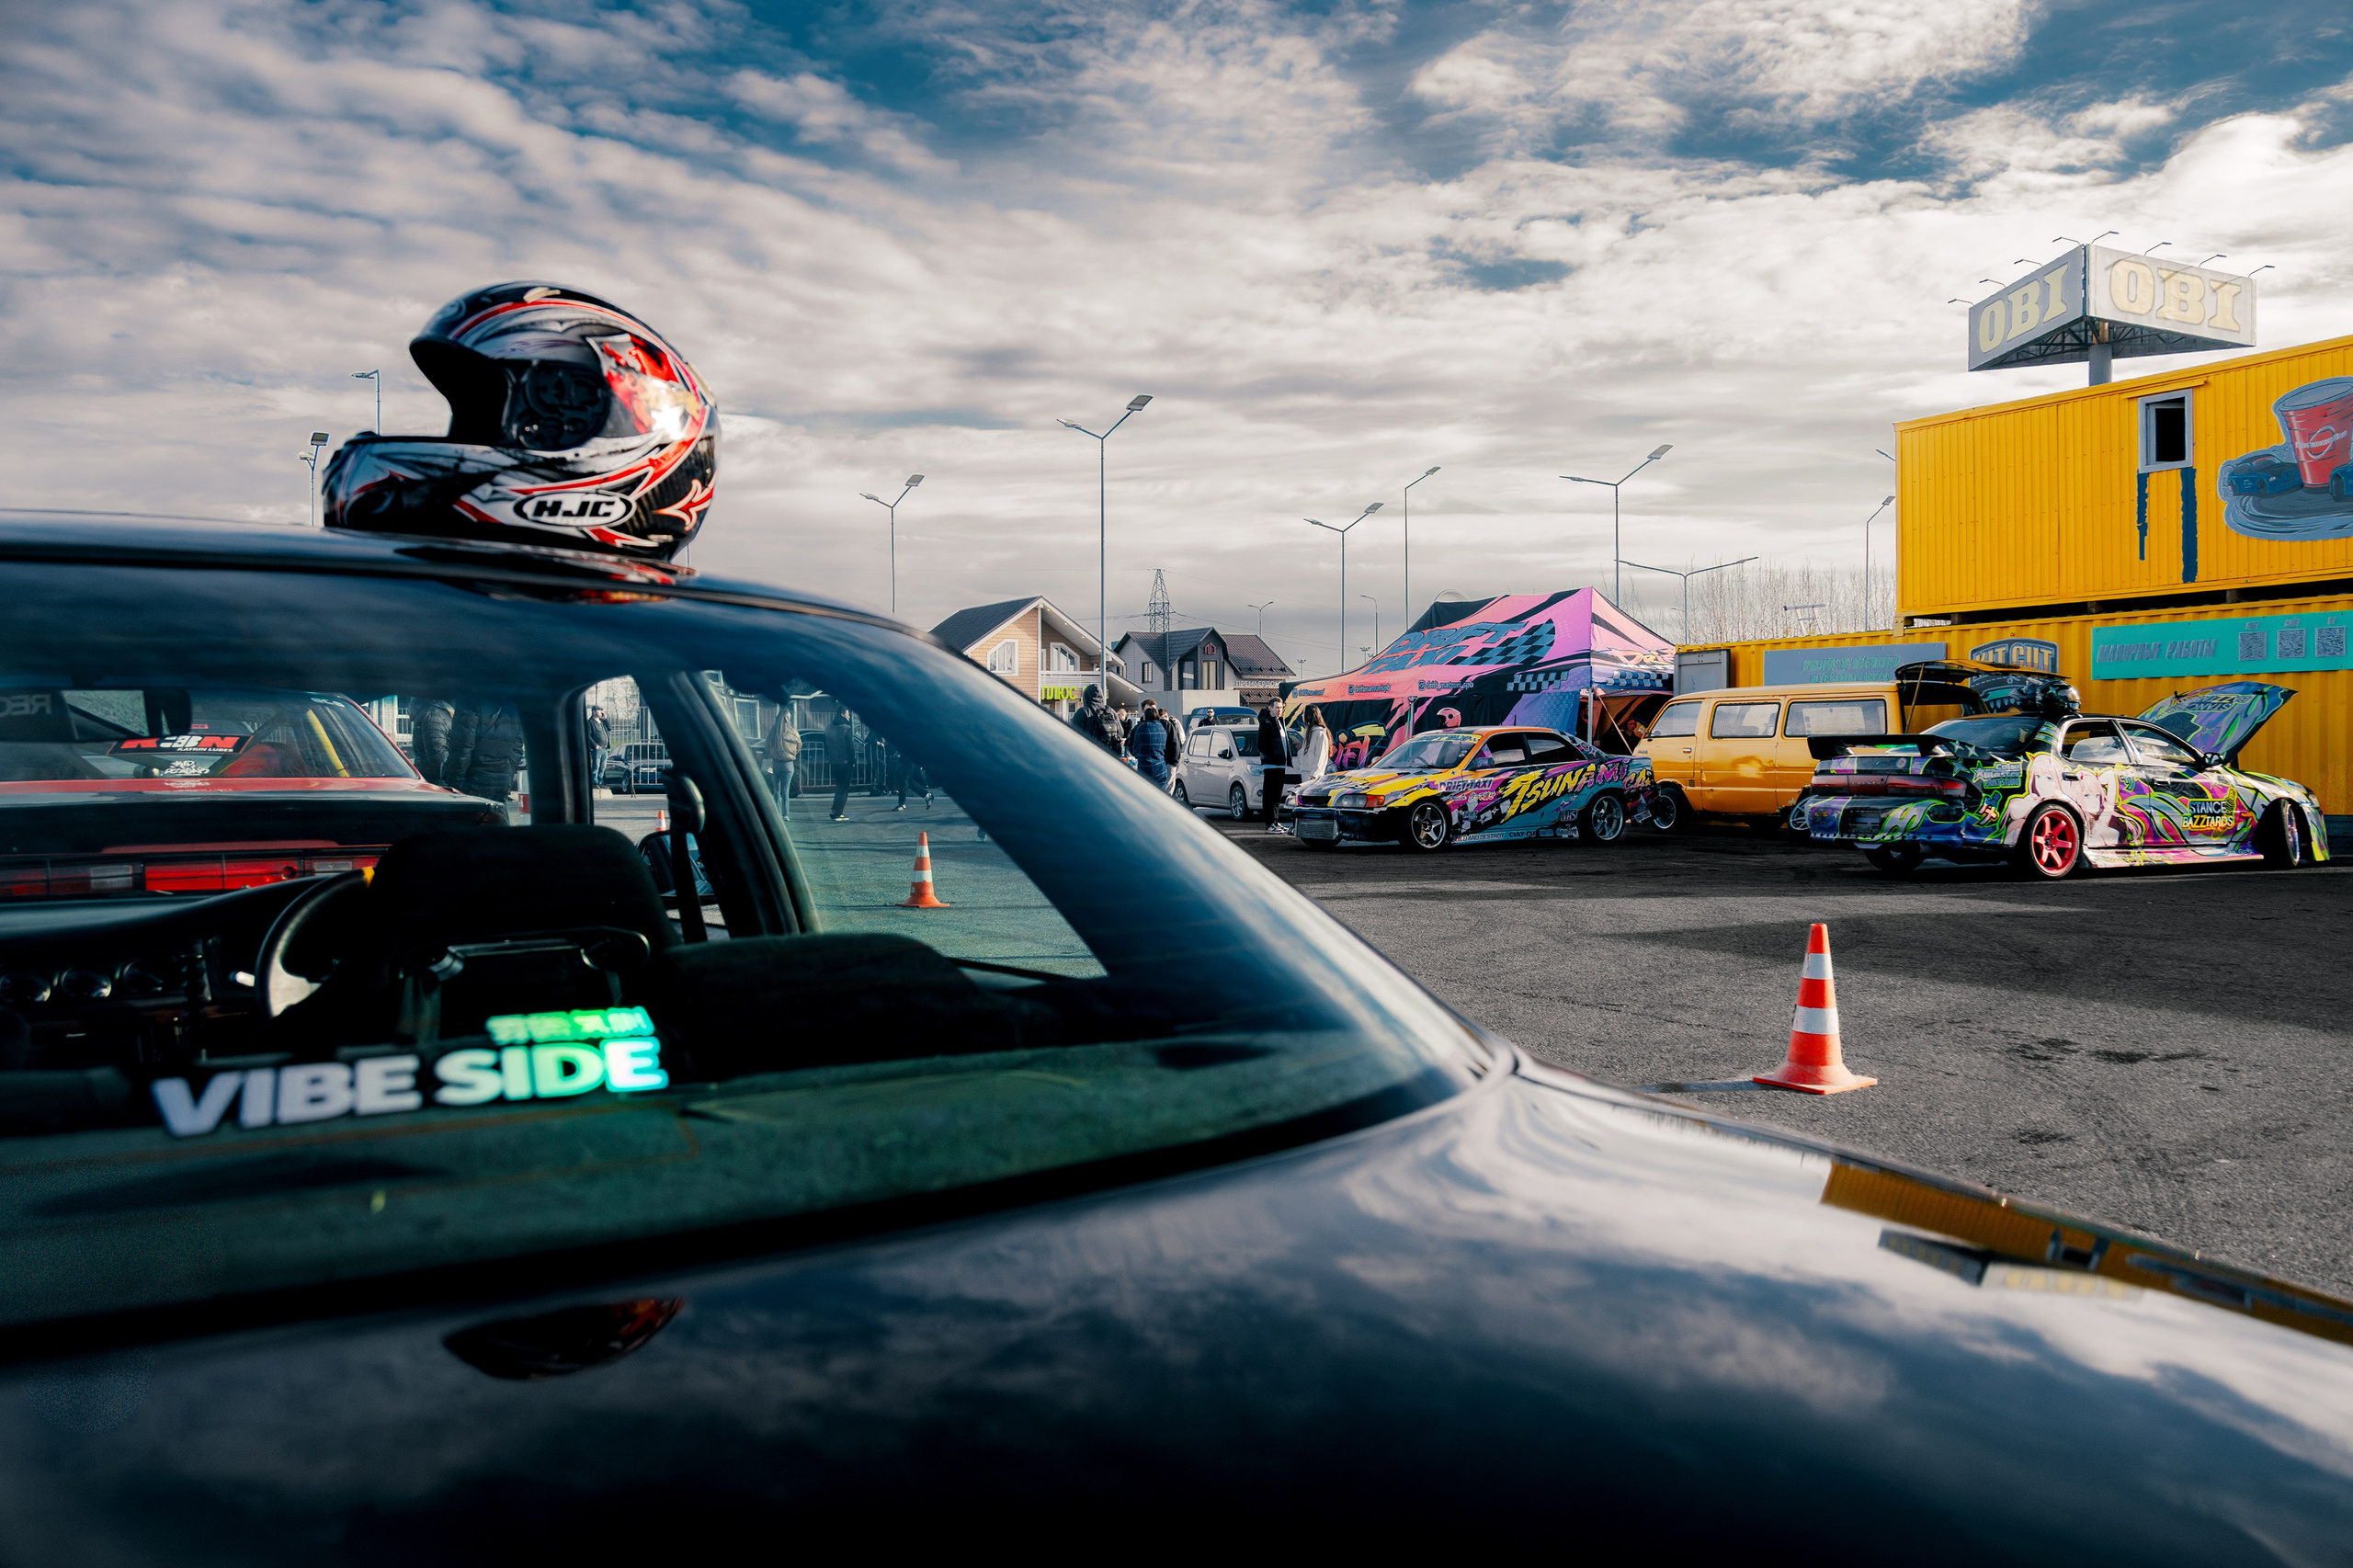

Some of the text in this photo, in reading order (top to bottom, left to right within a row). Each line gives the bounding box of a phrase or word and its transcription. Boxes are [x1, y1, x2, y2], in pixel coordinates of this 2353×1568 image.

[2109, 259, 2243, 333] OBI
[1978, 263, 2070, 354] OBI
[533, 500, 616, 517] HJC
[2011, 644, 2054, 672] CUT
[2165, 639, 2217, 660] РАБОТЫ
[1041, 686, 1077, 700] ПЛЮС
[2189, 801, 2227, 813] STANCE
[2183, 815, 2234, 828] BAZZTARDS
[151, 1036, 669, 1138] VIBE SIDE
